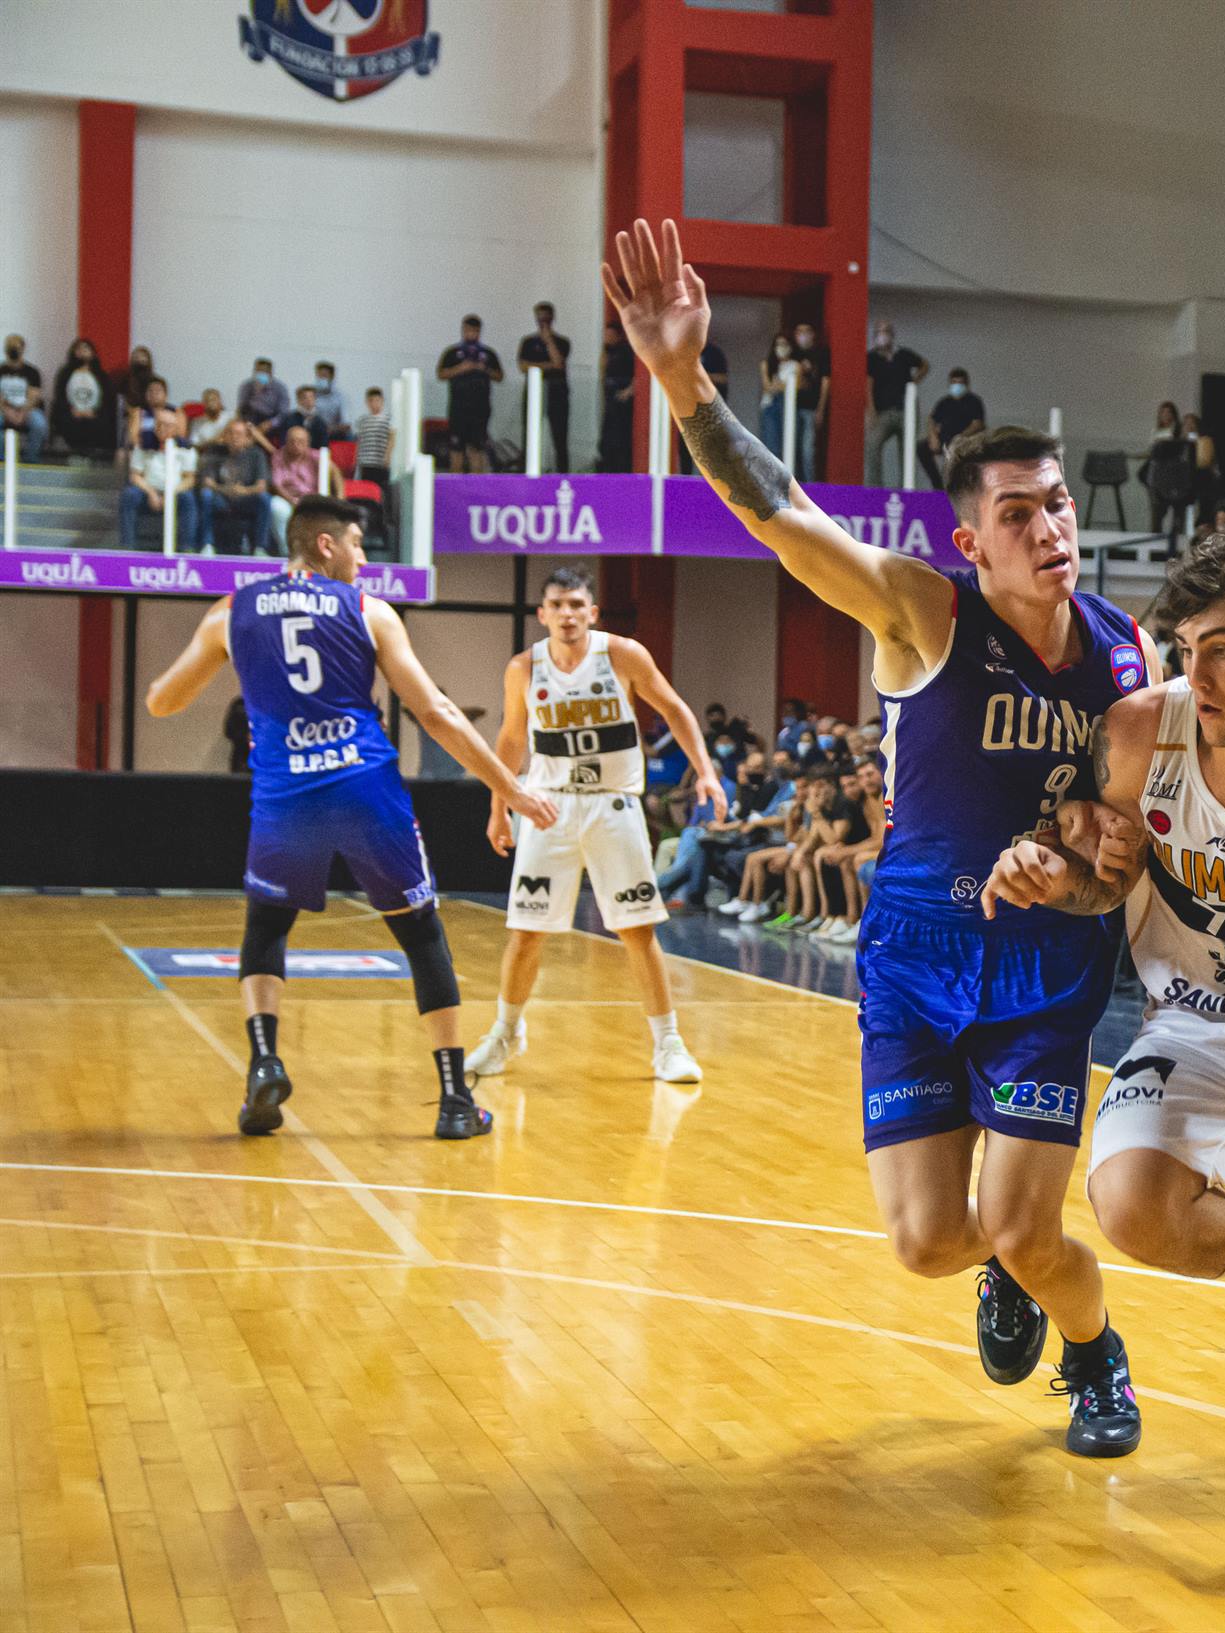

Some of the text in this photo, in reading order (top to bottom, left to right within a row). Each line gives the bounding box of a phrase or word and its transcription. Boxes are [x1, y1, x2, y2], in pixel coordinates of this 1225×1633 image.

[256, 591, 339, 617] GRAMAJO
[281, 616, 323, 694] 5
[285, 716, 357, 751] Secco
[982, 693, 1104, 755] QUIM
[563, 729, 599, 756] 10
[884, 1081, 953, 1104] SANTIAGO
[1012, 1081, 1079, 1115] BSE
